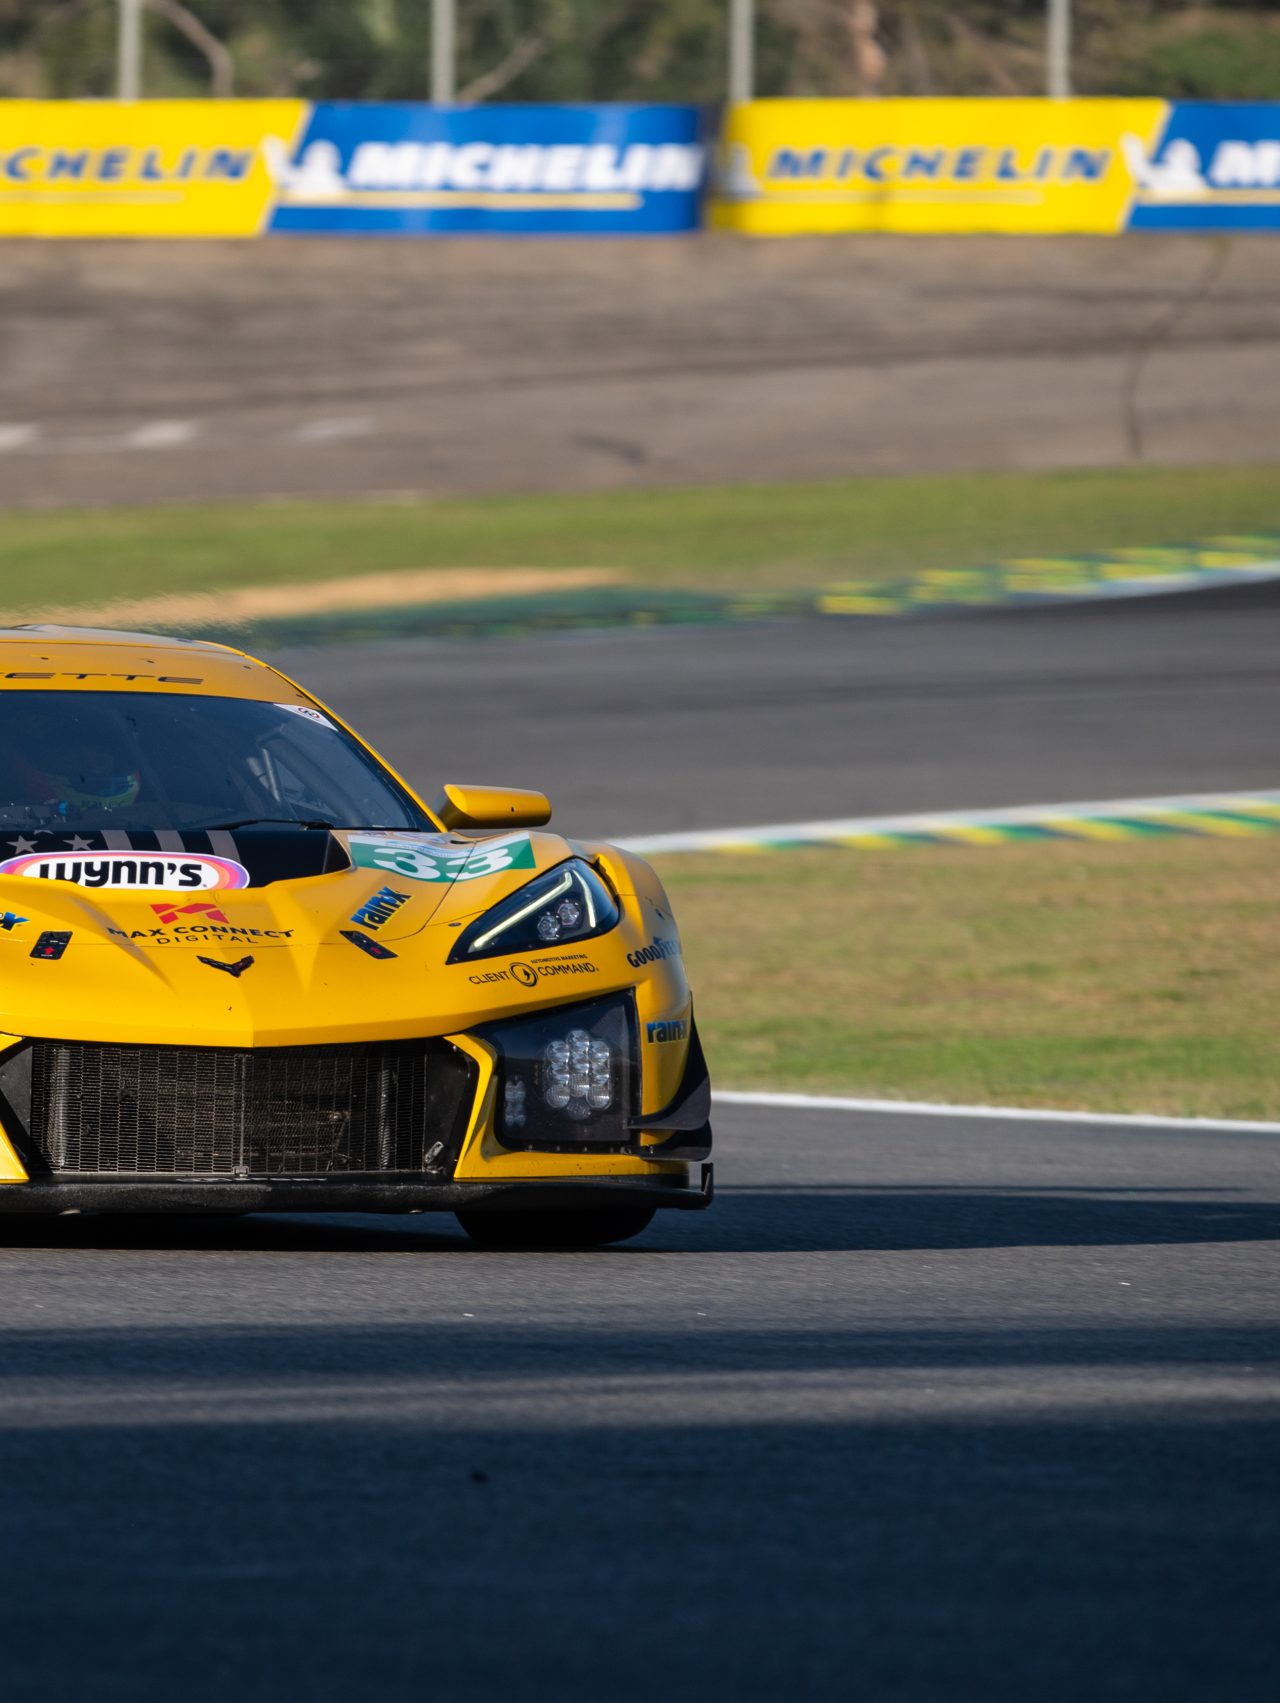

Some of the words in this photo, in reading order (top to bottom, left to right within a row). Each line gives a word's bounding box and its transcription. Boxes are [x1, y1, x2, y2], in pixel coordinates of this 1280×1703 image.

[347, 140, 706, 190] MICHELIN
[766, 146, 1111, 181] MICHELIN
[39, 860, 203, 888] wynn's
[373, 847, 514, 880] 33
[108, 926, 164, 939] MAX
[174, 926, 296, 939] CONNECT
[156, 934, 259, 945] DIGITAL
[469, 971, 510, 985] CLIENT
[538, 962, 596, 977] COMMAND
